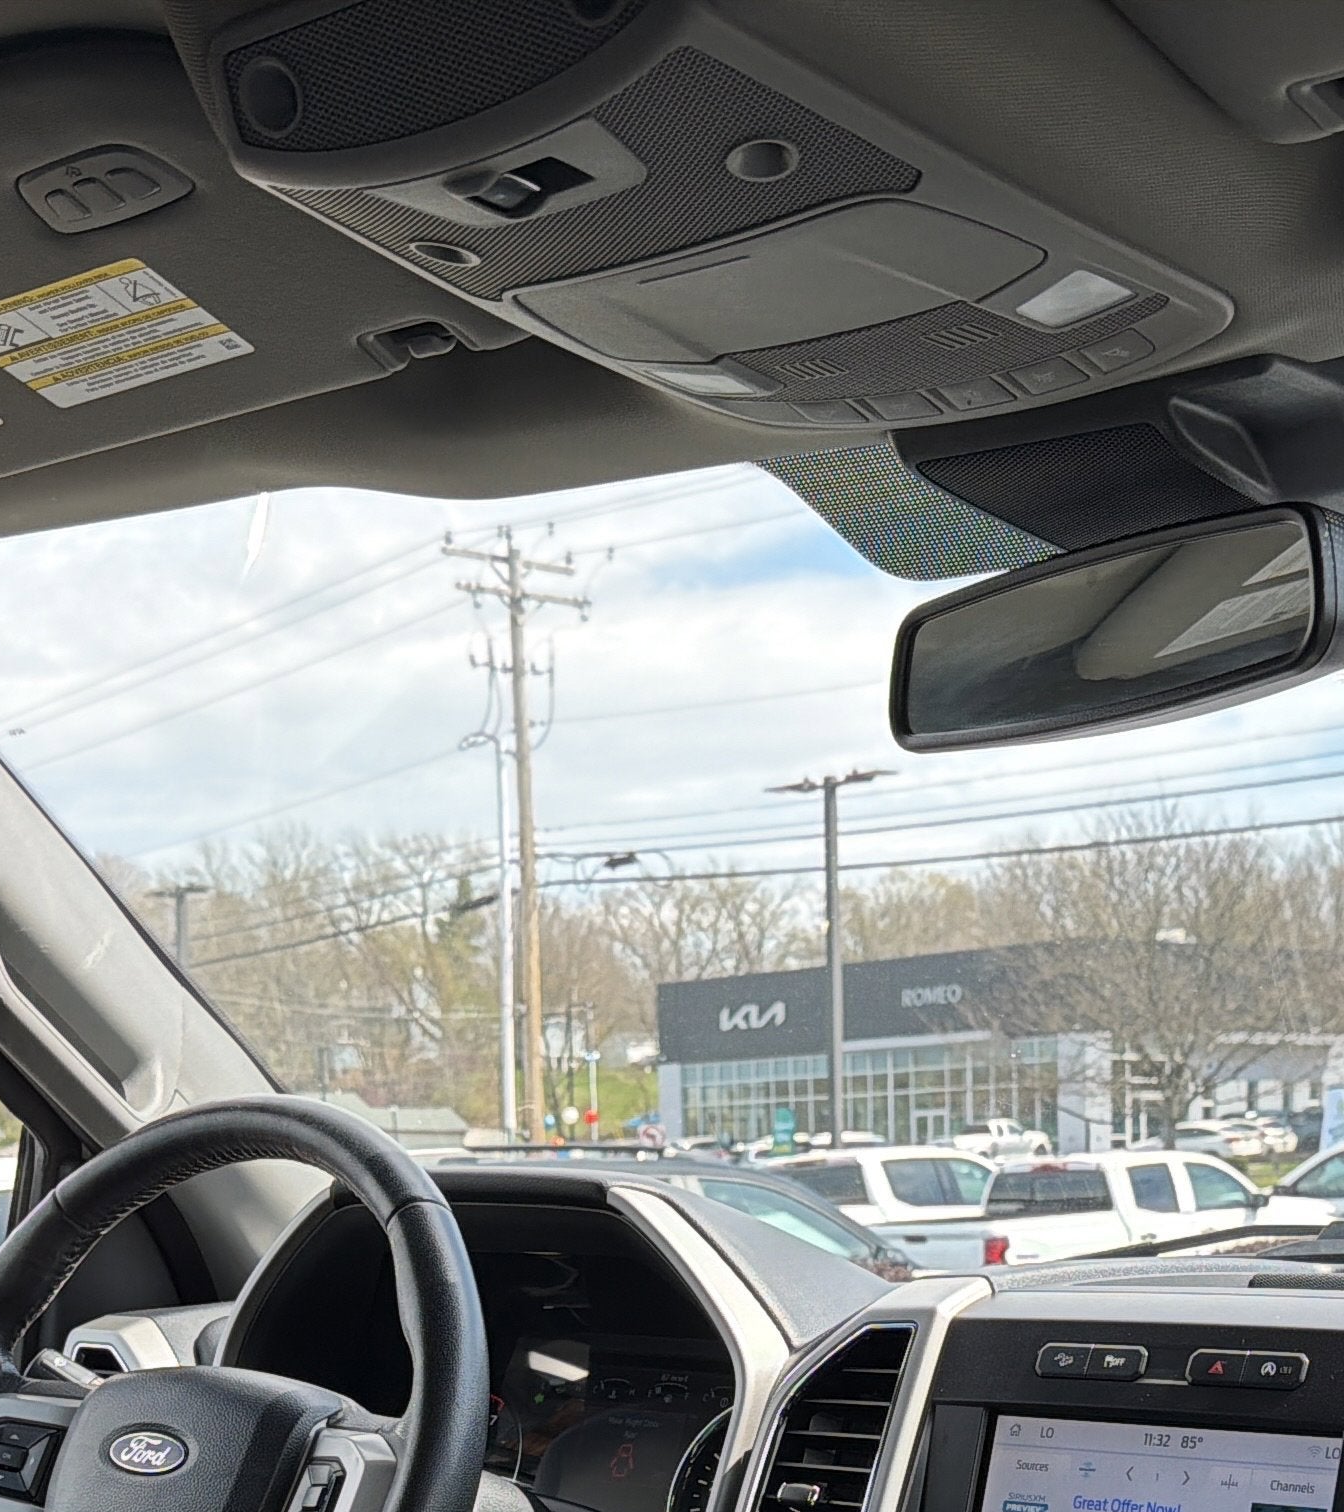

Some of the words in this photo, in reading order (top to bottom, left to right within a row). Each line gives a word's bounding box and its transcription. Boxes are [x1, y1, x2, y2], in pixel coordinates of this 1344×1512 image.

[901, 983, 962, 1008] ROMEO
[719, 1000, 786, 1032] KIA
[1040, 1426, 1054, 1439] LO
[1143, 1433, 1171, 1448] 11:32
[120, 1436, 171, 1466] Ford
[1325, 1446, 1341, 1460] LO
[1016, 1459, 1049, 1472] Sources
[1270, 1479, 1315, 1494] Channels
[1073, 1495, 1106, 1512] Great
